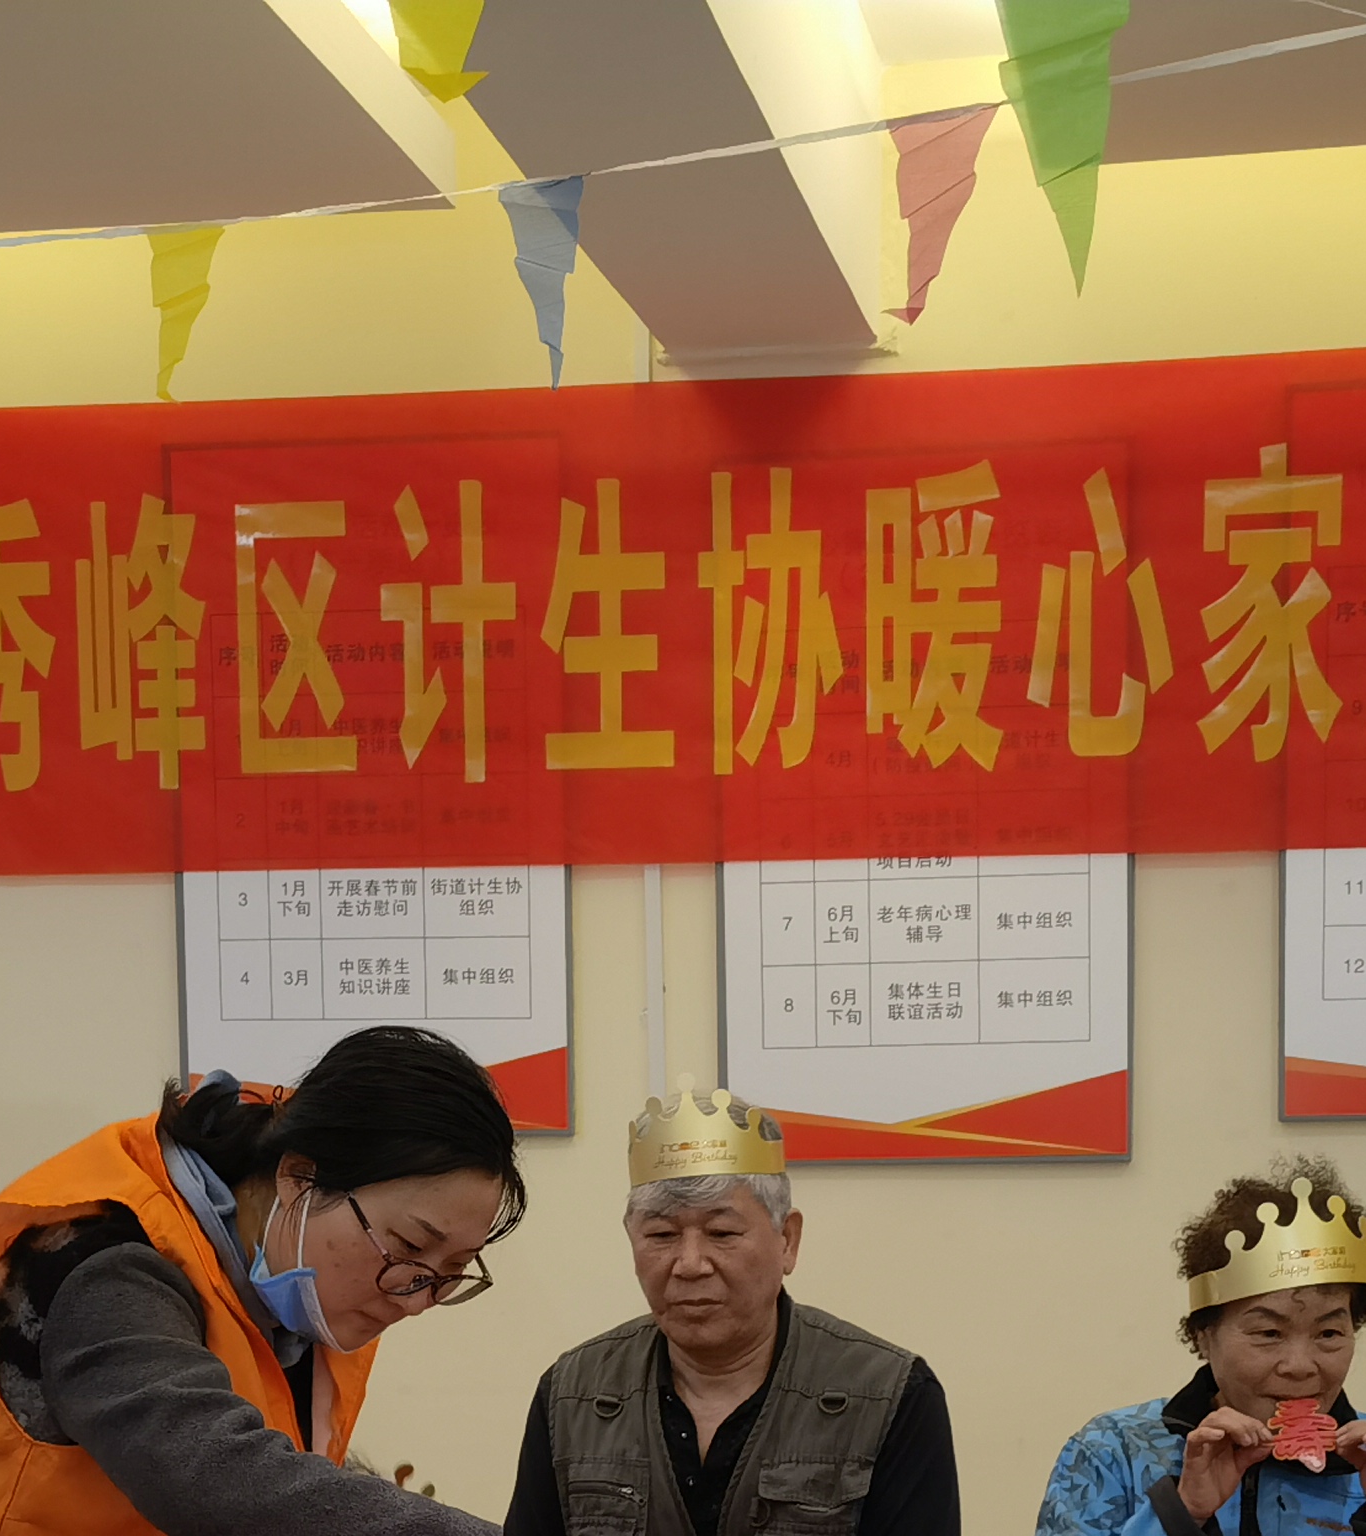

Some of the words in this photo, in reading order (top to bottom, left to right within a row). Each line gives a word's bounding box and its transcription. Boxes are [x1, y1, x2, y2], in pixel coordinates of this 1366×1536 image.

[281, 880, 305, 898] 1月
[327, 878, 418, 898] 开展春节前
[430, 876, 523, 896] 街道计生协
[1344, 879, 1364, 895] 11
[238, 891, 248, 907] 3
[276, 899, 311, 918] 下旬
[336, 898, 408, 918] 走访慰问
[459, 898, 495, 916] 组织
[827, 904, 854, 923] 6月
[876, 903, 972, 924] 老年病心理
[996, 910, 1073, 930] 集中组织
[782, 916, 793, 932] 7
[822, 925, 859, 944] 上旬
[905, 924, 943, 944] 辅导
[339, 957, 410, 976] 中医养生
[1344, 958, 1365, 974] 12
[240, 971, 250, 986] 4
[283, 969, 308, 987] 3月
[442, 967, 515, 985] 集中组织
[339, 976, 411, 996] 知识讲座
[887, 981, 961, 1002] 集体生日
[783, 997, 795, 1013] 8
[830, 988, 857, 1007] 6月
[997, 989, 1073, 1009] 集中组织
[826, 1007, 862, 1026] 下旬
[887, 1001, 963, 1022] 联谊活动
[1269, 1263, 1310, 1278] Happy
[1314, 1258, 1356, 1274] Birthday
